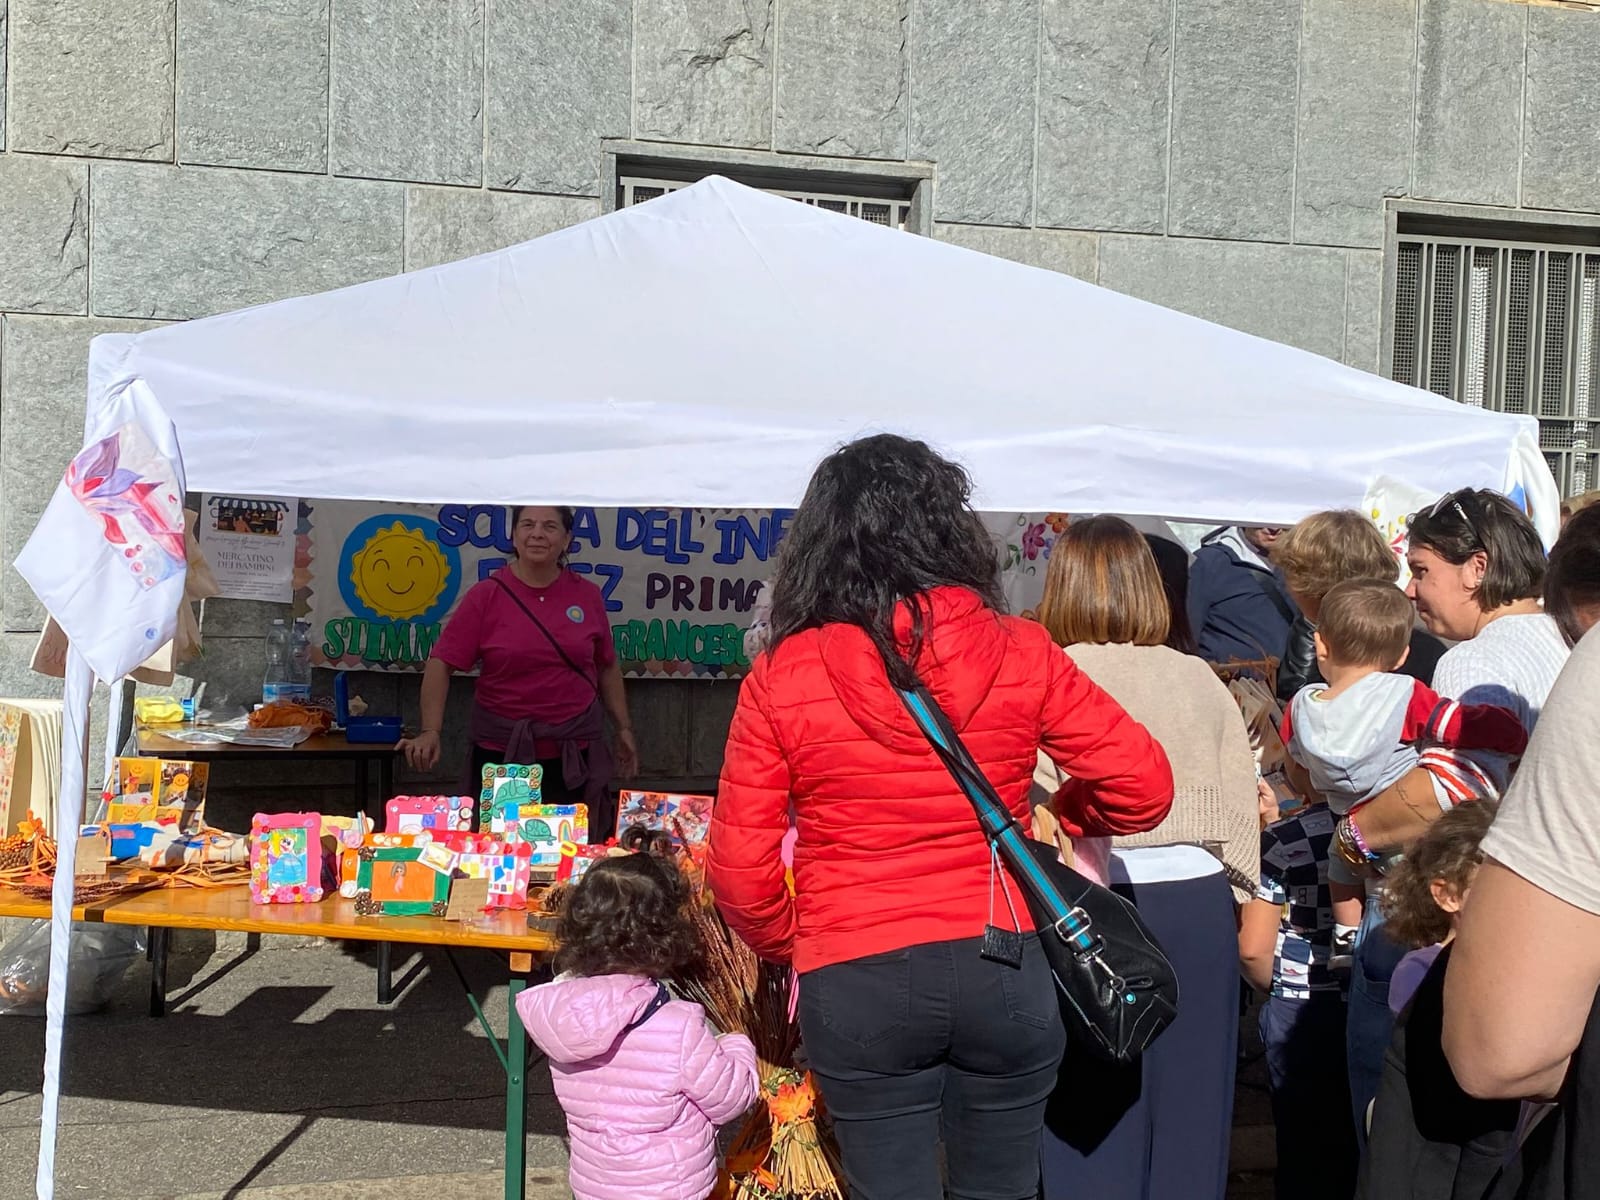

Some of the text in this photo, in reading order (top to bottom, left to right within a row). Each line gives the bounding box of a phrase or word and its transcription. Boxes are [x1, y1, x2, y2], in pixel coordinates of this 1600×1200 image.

[436, 504, 800, 565] SCUA DELL'INF
[217, 551, 274, 563] MERCATINO
[217, 561, 274, 572] DEI BAMBINI
[646, 573, 764, 612] PRIMA
[322, 617, 752, 666] STIMM FRANCESC
